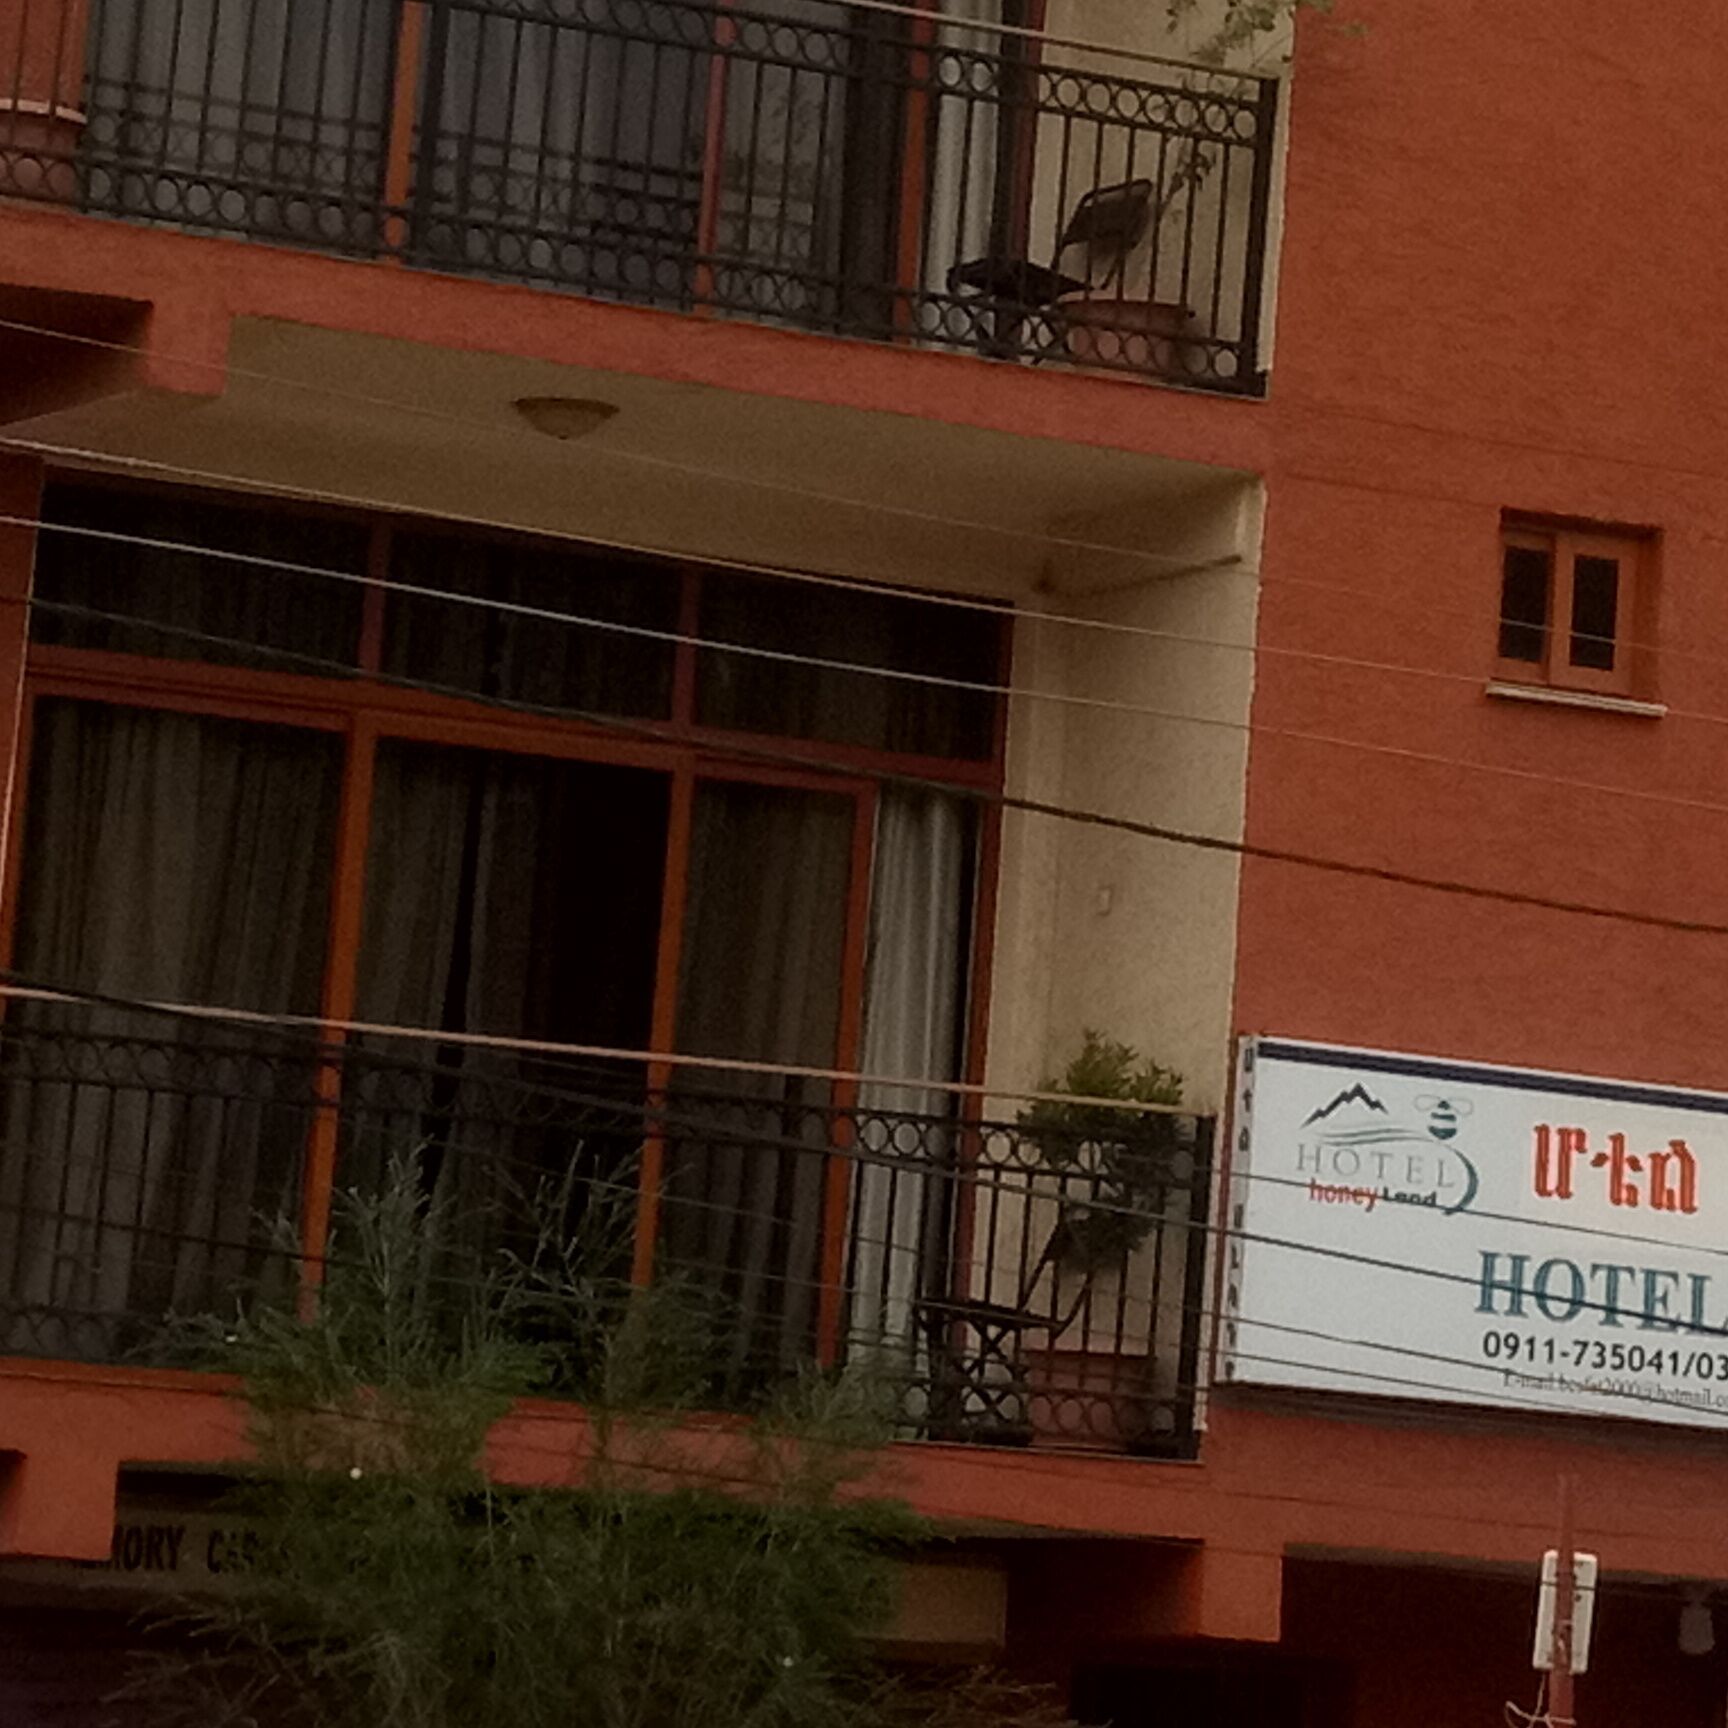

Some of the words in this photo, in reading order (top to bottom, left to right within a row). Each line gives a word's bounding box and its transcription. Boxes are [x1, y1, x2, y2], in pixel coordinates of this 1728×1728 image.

[1296, 1143, 1455, 1188] HOTEL
[1533, 1123, 1698, 1214] ሆቴል
[1309, 1177, 1378, 1212] honey
